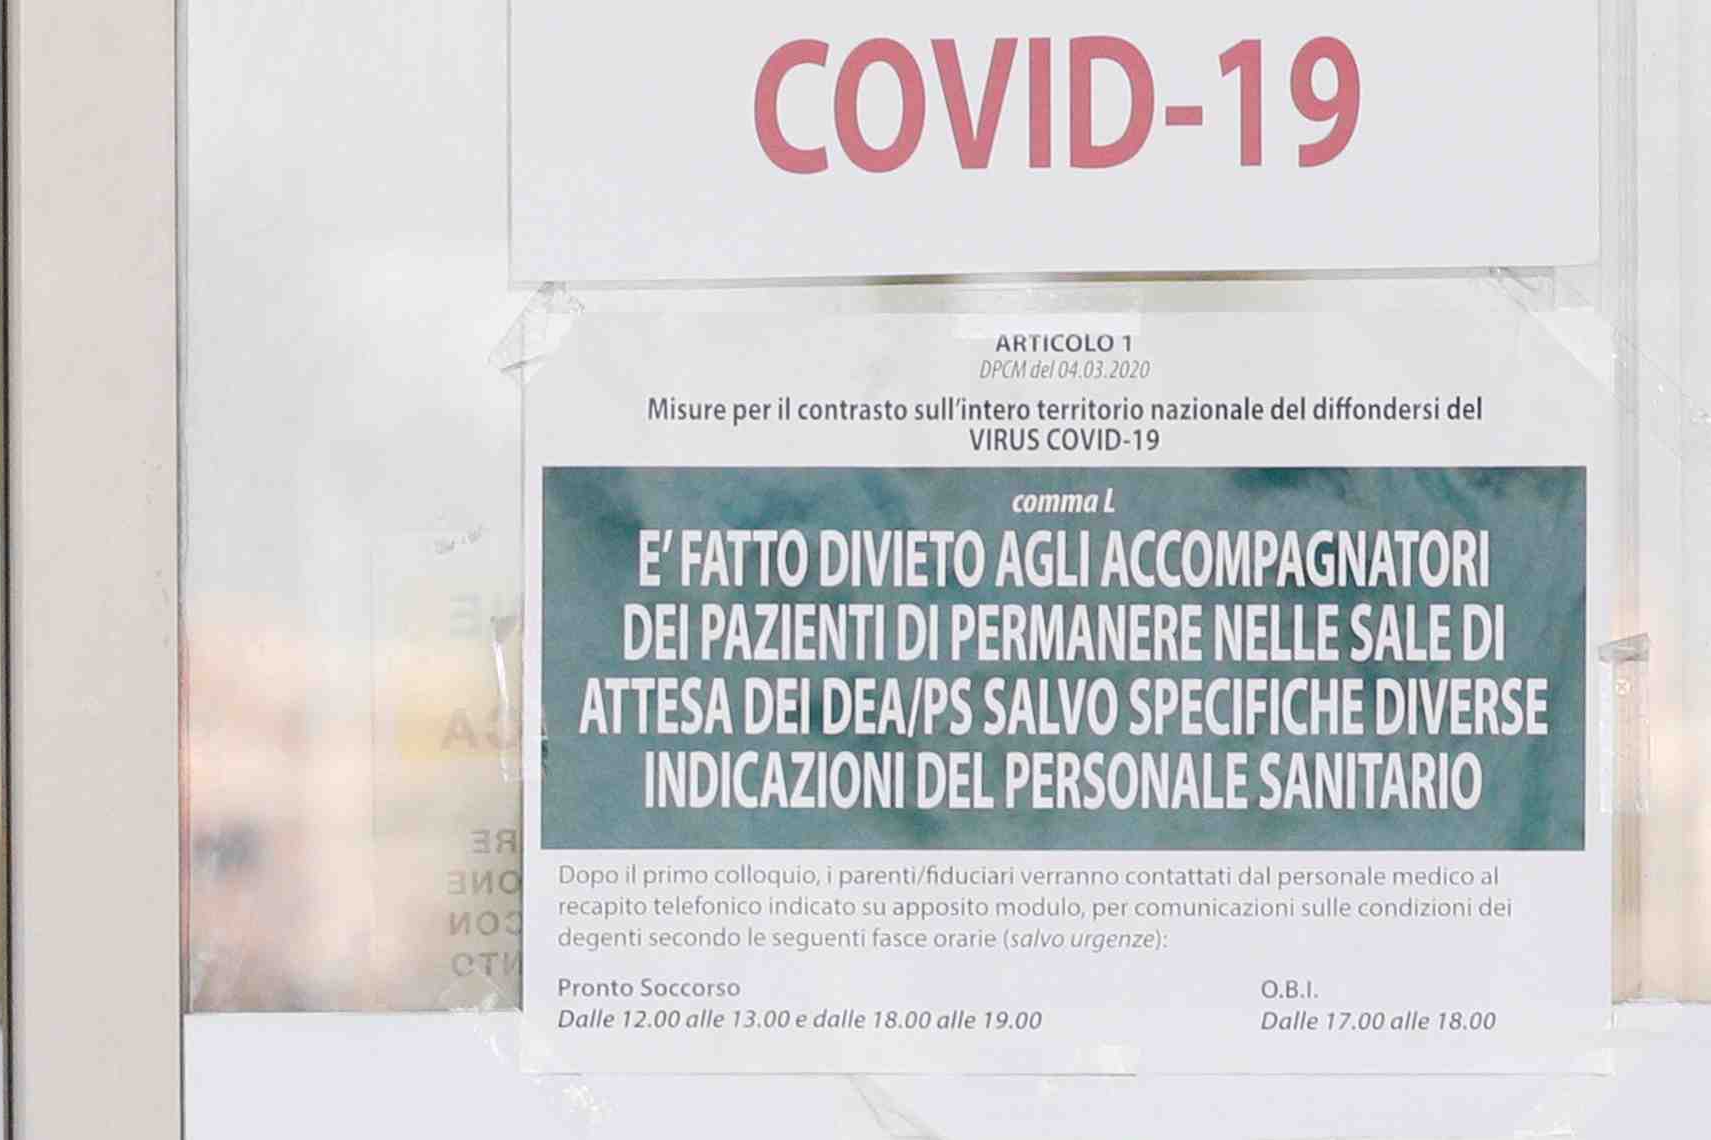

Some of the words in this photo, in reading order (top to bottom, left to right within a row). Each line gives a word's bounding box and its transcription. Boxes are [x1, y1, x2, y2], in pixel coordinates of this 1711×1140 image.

[754, 36, 1360, 174] COVID-19
[996, 333, 1114, 352] ARTICOLO
[1123, 335, 1131, 352] 1
[979, 359, 1028, 378] DPCM
[1031, 359, 1054, 378] del
[1057, 359, 1151, 378] 04.03.2020
[649, 398, 725, 420] Misure
[734, 404, 770, 426] per
[779, 397, 790, 419] il
[798, 401, 907, 420] contrasto
[1038, 398, 1143, 420] territorio
[1152, 397, 1263, 420] nazionale
[1271, 397, 1305, 420] del
[1313, 397, 1439, 420] diffondersi
[1447, 396, 1481, 420] del
[970, 429, 1039, 450] VIRUS
[1047, 428, 1159, 450] COVID-19
[1013, 494, 1098, 512] comma
[1104, 488, 1114, 512] L
[682, 529, 807, 586] FATTO
[821, 530, 984, 587] DIVIETO
[996, 530, 1089, 587] AGLI
[1101, 530, 1488, 587] ACCOMPAGNATORI
[624, 604, 688, 660] DEI
[702, 604, 884, 660] PAZIENTI
[898, 604, 938, 660] DI
[952, 605, 1202, 661] PERMANERE
[1215, 605, 1338, 661] NELLE
[1351, 604, 1450, 661] SALE
[1464, 604, 1503, 661] DI
[580, 677, 732, 734] ATTESA
[745, 678, 809, 734] DEI
[824, 677, 972, 737] DEA/PS
[984, 678, 1117, 735] SALVO
[1130, 678, 1363, 735] SPECIFICHE
[1377, 678, 1547, 735] DIVERSE
[646, 751, 903, 808] INDICAZIONI
[918, 752, 994, 808] DEL
[1007, 752, 1247, 809] PERSONALE
[1260, 752, 1482, 809] SANITARIO
[560, 866, 618, 888] Dopo
[626, 864, 635, 883] il
[644, 866, 707, 888] primo
[715, 864, 819, 888] colloquio,
[827, 865, 832, 884] i
[840, 865, 1013, 888] parenti/fiduciari
[1021, 871, 1118, 885] verranno
[1126, 867, 1230, 885] contattati
[1239, 866, 1270, 885] dal
[1279, 866, 1385, 889] personale
[1394, 867, 1474, 885] medico
[1482, 867, 1498, 884] al
[560, 897, 646, 919] recapito
[654, 896, 761, 915] telefonico
[770, 897, 855, 915] indicato
[863, 902, 885, 915] su
[893, 898, 988, 920] apposito
[996, 897, 1084, 918] modulo,
[1093, 903, 1127, 920] per
[1135, 899, 1293, 916] comunicazioni
[1302, 898, 1351, 916] sulle
[1358, 898, 1471, 916] condizioni
[1479, 898, 1511, 916] dei
[558, 928, 641, 951] degenti
[650, 928, 740, 946] secondo
[749, 928, 765, 946] le
[773, 930, 864, 951] seguenti
[873, 928, 926, 947] fasce
[934, 930, 996, 947] orarie
[1004, 928, 1064, 949] (salvo
[1071, 930, 1167, 953] urgenze):
[559, 979, 633, 996] Pronto
[641, 978, 740, 996] Soccorso
[1262, 980, 1317, 998] O.B.I.
[558, 1009, 614, 1028] Dalle
[624, 1010, 681, 1028] 12.00
[687, 1010, 724, 1028] alle
[735, 1010, 791, 1028] 13.00
[796, 1015, 807, 1028] e
[813, 1010, 865, 1028] dalle
[876, 1011, 931, 1028] 18.00
[937, 1010, 975, 1029] alle
[985, 1012, 1042, 1029] 19.00
[1262, 1011, 1318, 1030] Dalle
[1328, 1013, 1384, 1030] 17.00
[1391, 1011, 1429, 1030] alle
[1440, 1012, 1496, 1030] 18.00
